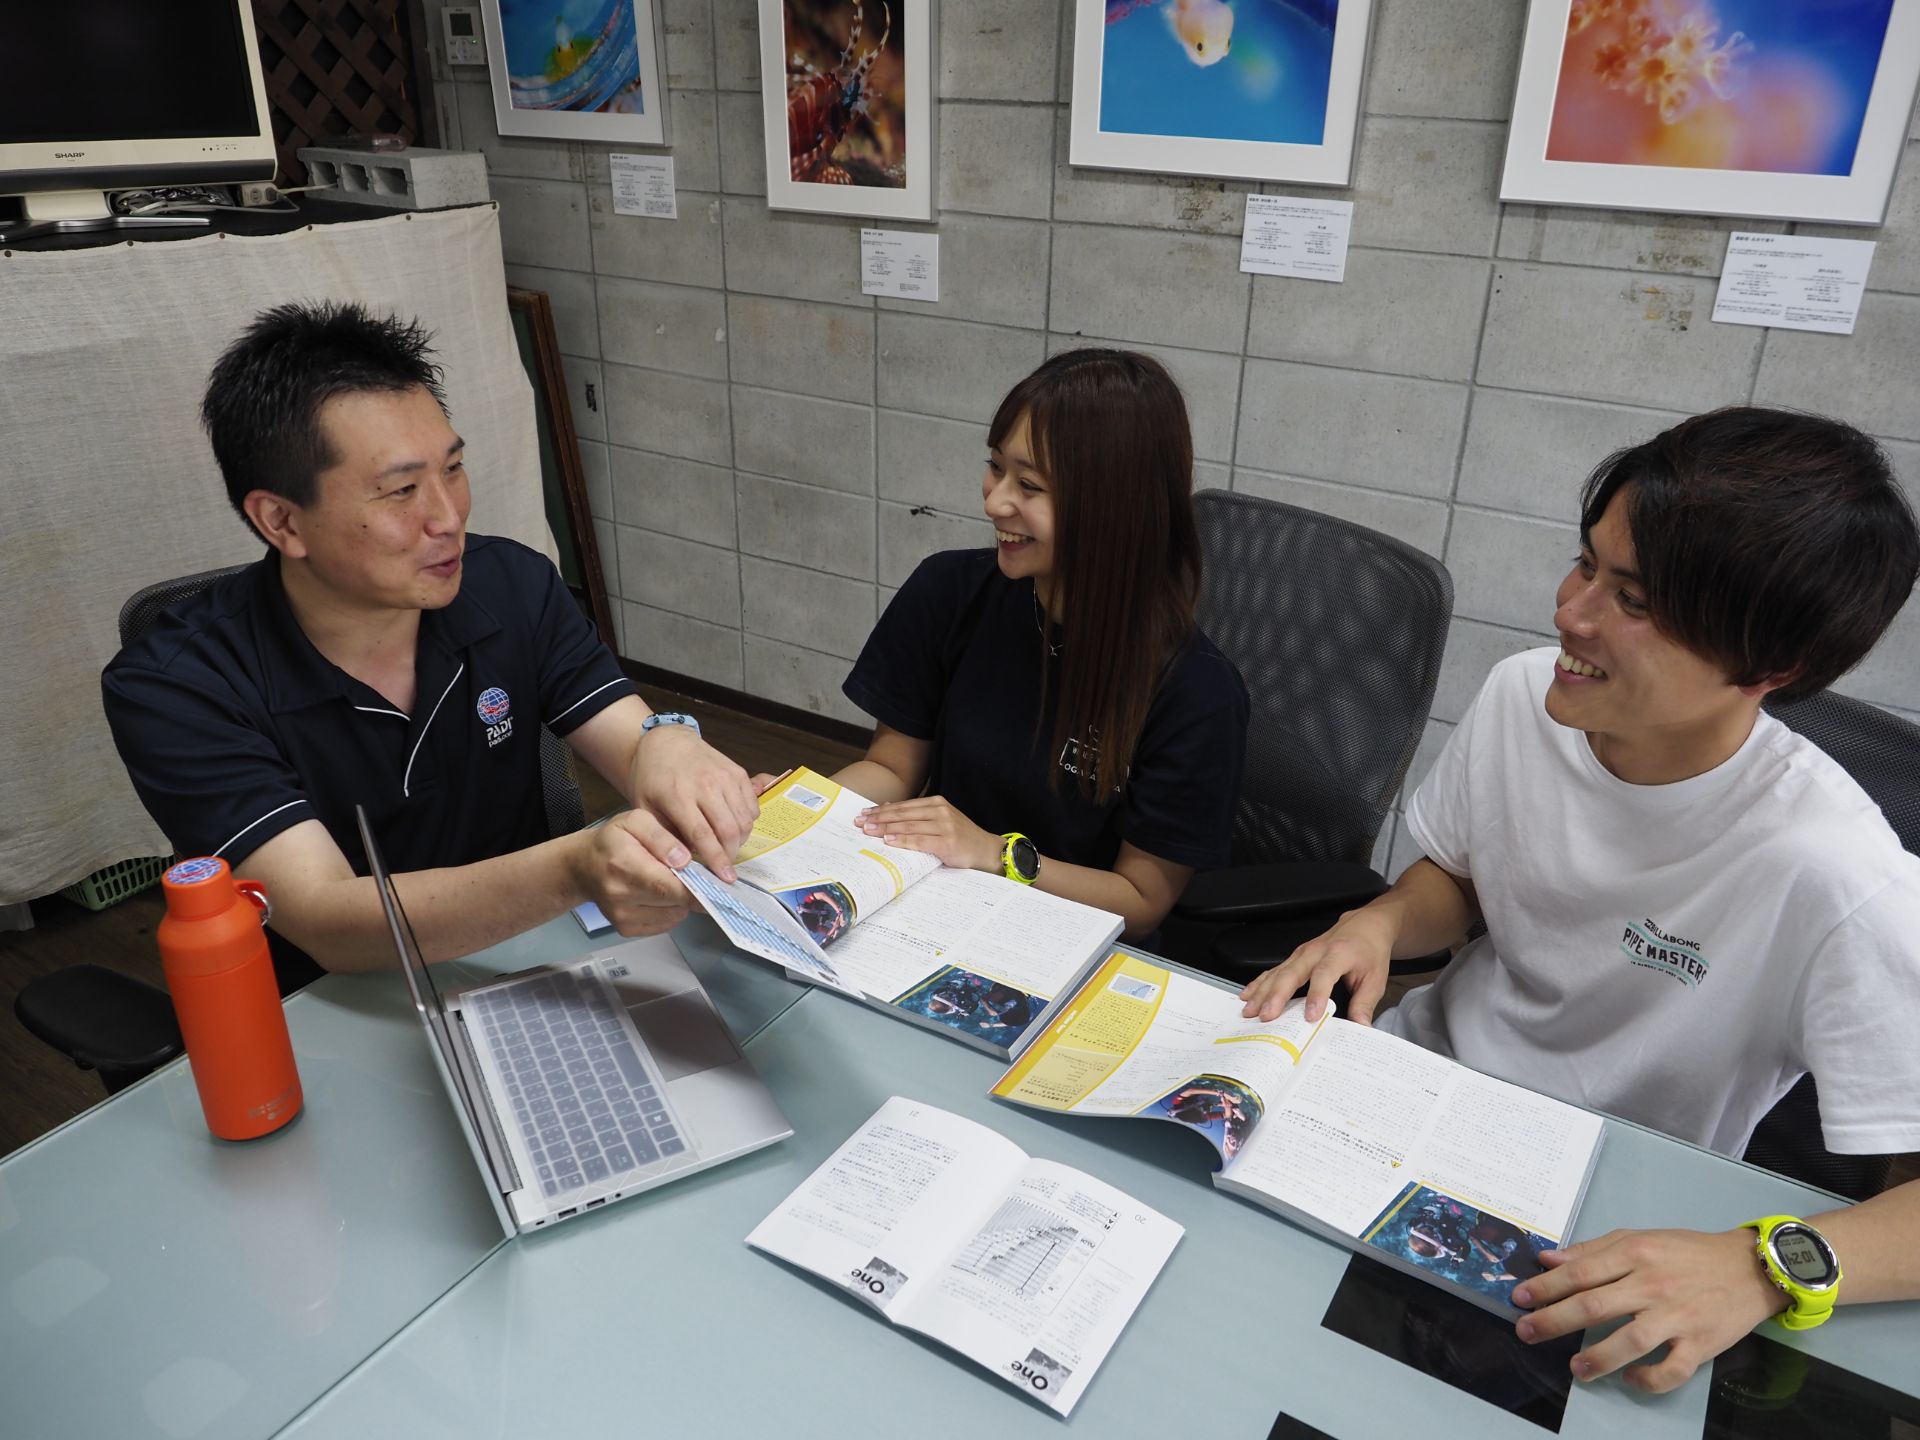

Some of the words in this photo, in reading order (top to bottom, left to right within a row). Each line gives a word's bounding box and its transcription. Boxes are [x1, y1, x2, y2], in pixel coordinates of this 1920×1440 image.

[486, 718, 512, 740] PADI
[1650, 923, 1701, 951] BILLABONG
[1622, 927, 1645, 955] PIPE
[1646, 944, 1707, 985] MASTERS
[1135, 1214, 1147, 1224] 20
[850, 1267, 885, 1294] One
[1011, 1360, 1049, 1391] One
